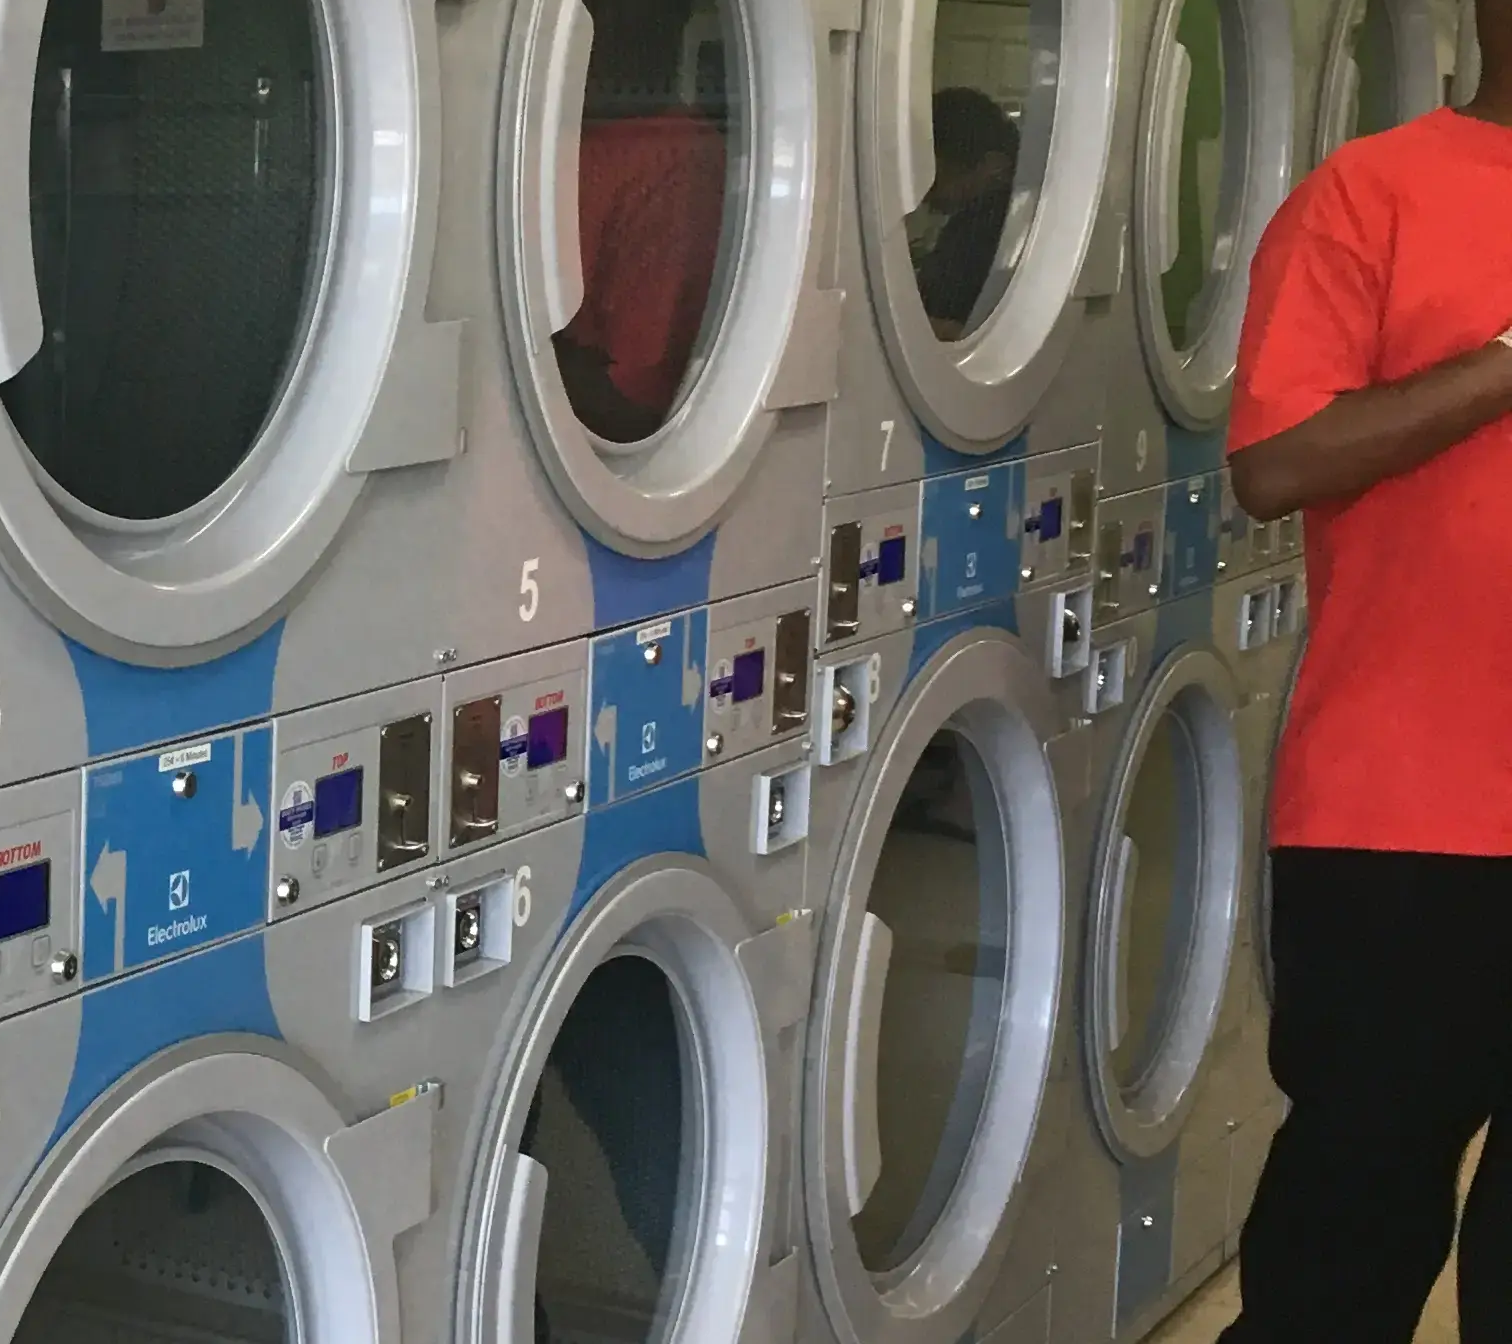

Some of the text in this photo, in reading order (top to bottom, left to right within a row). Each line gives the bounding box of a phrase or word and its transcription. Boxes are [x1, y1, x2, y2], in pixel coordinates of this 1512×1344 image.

[881, 420, 895, 472] 7
[1136, 429, 1147, 473] 9
[519, 557, 539, 622] 5
[512, 865, 532, 928] 6
[148, 914, 207, 946] Electrolux
